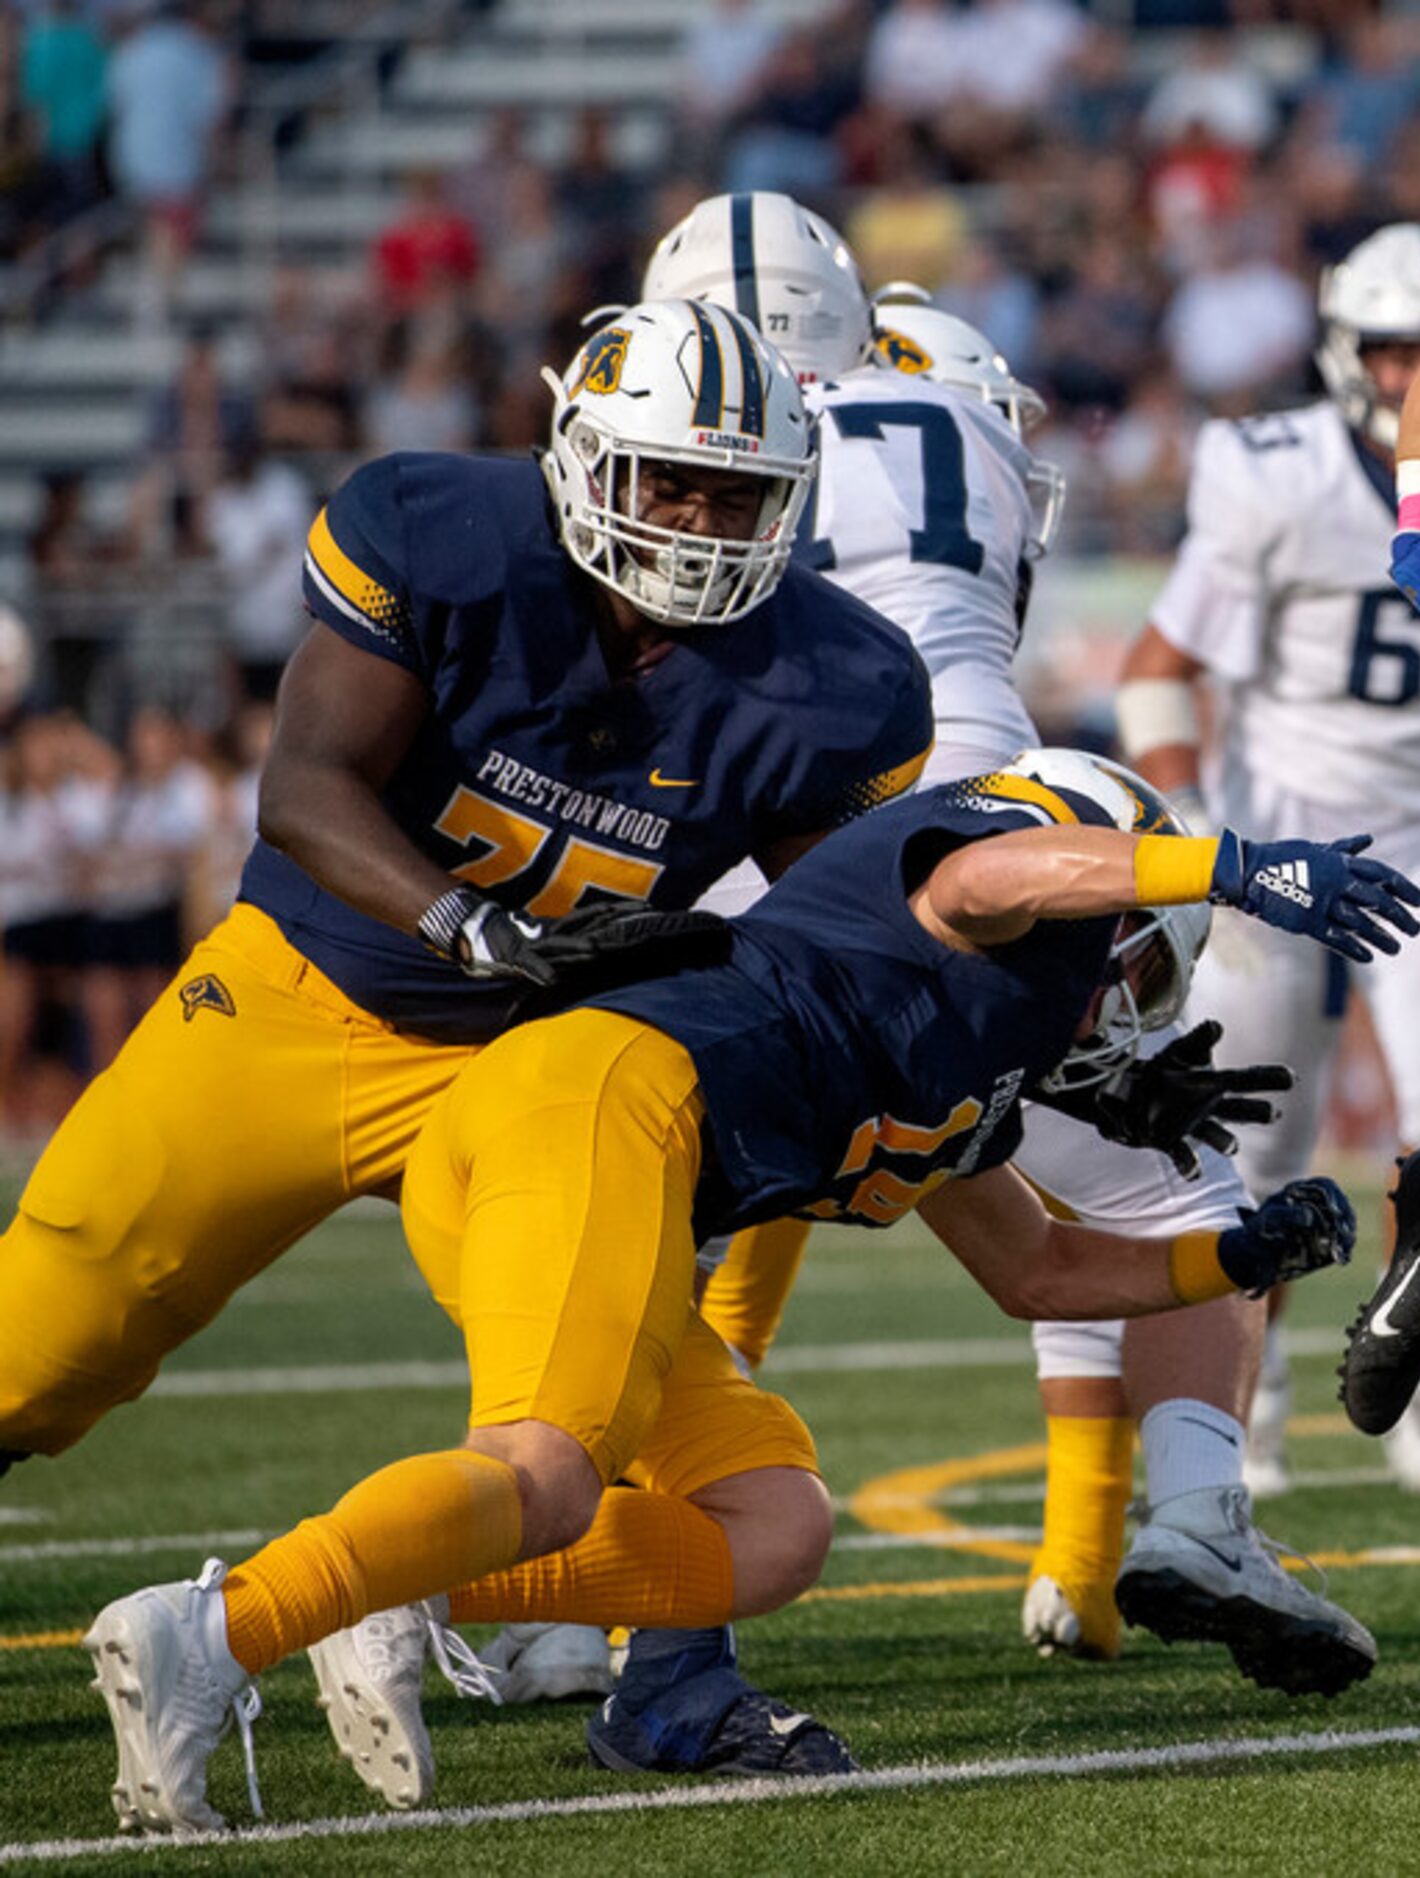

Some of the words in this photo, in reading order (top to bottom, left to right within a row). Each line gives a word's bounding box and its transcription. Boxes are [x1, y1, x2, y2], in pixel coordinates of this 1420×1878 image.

[767, 313, 789, 331] 77
[477, 750, 671, 850] PRESTONWOOD
[1255, 870, 1314, 909] adidas
